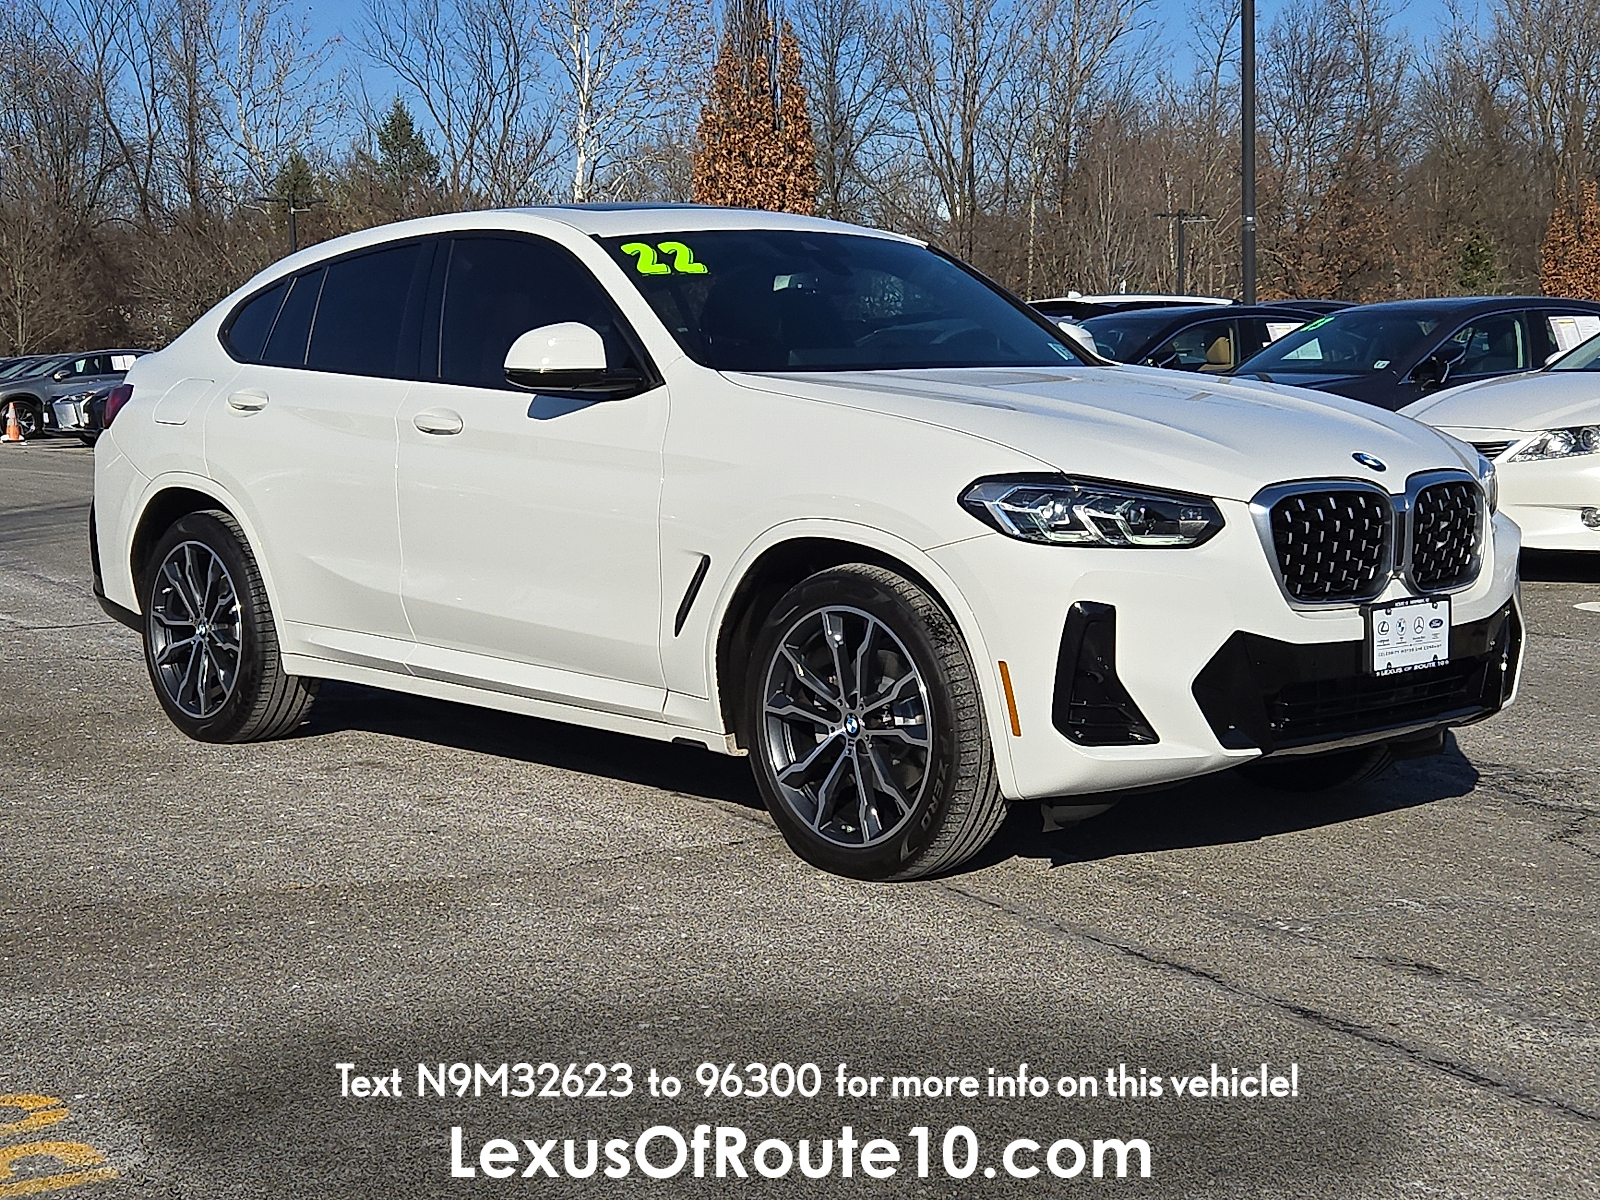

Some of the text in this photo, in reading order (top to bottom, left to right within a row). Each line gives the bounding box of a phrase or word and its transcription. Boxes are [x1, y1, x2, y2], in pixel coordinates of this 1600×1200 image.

[620, 241, 709, 276] 22
[1380, 667, 1403, 676] LEXUS
[1413, 662, 1436, 670] ROUTE
